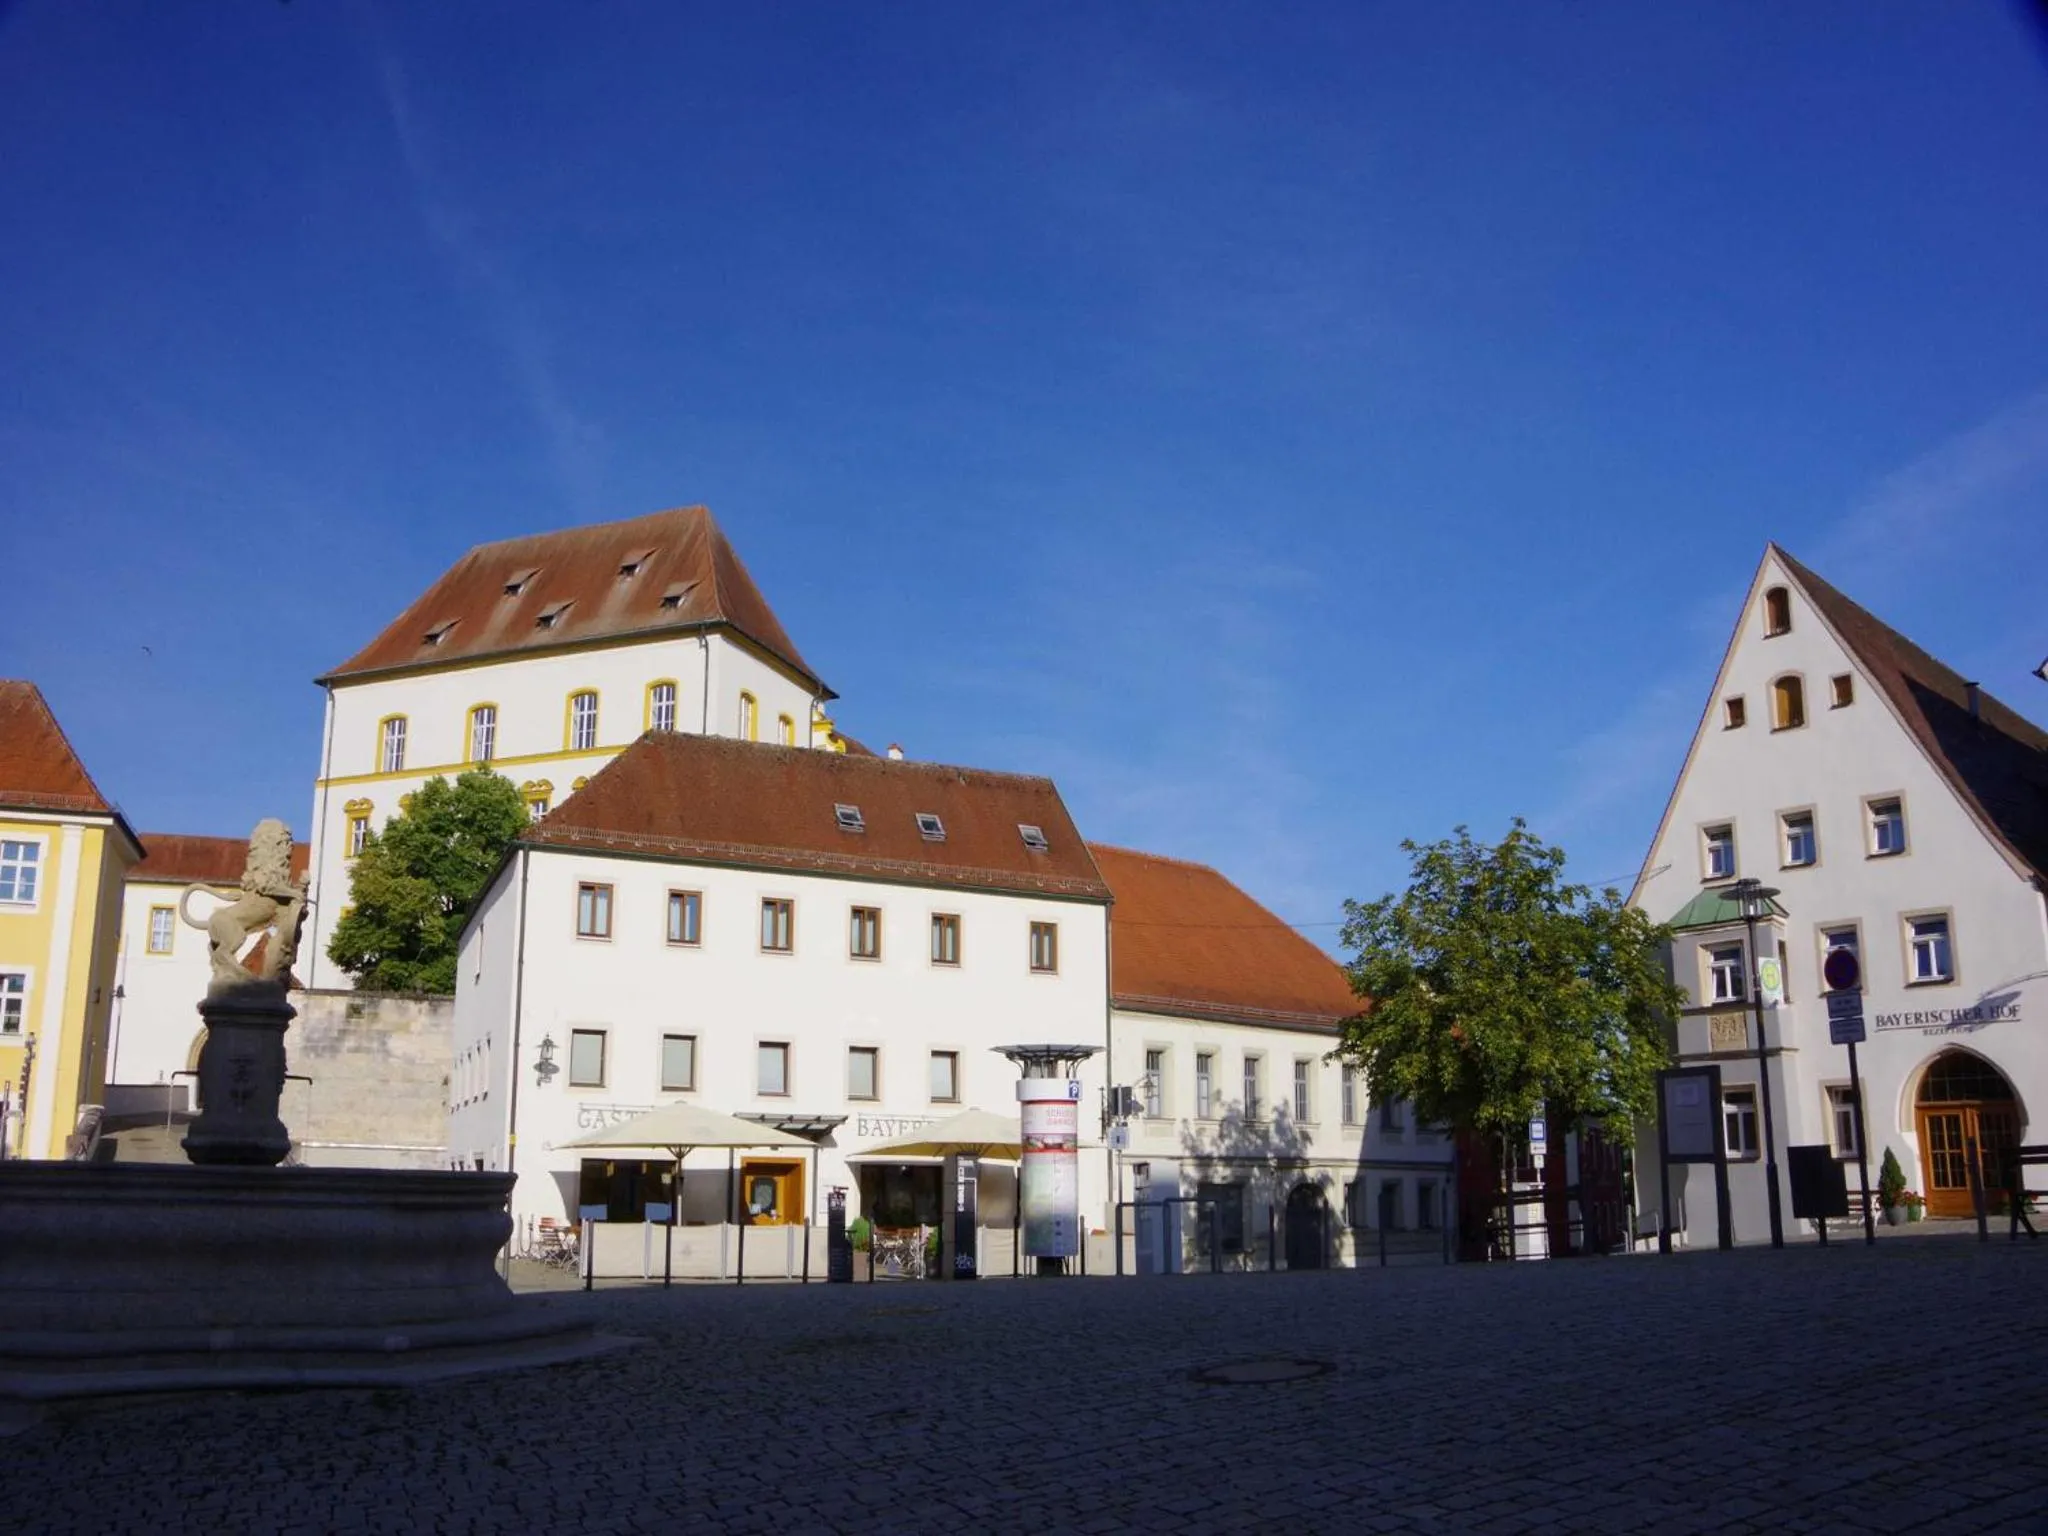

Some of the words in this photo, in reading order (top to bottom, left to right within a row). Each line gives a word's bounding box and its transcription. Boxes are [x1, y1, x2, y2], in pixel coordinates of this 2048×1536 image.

[1875, 1007, 1984, 1028] BAYERISCHER
[1989, 1004, 2021, 1019] HOF
[577, 1108, 651, 1129] GAST
[857, 1117, 935, 1137] BAYER
